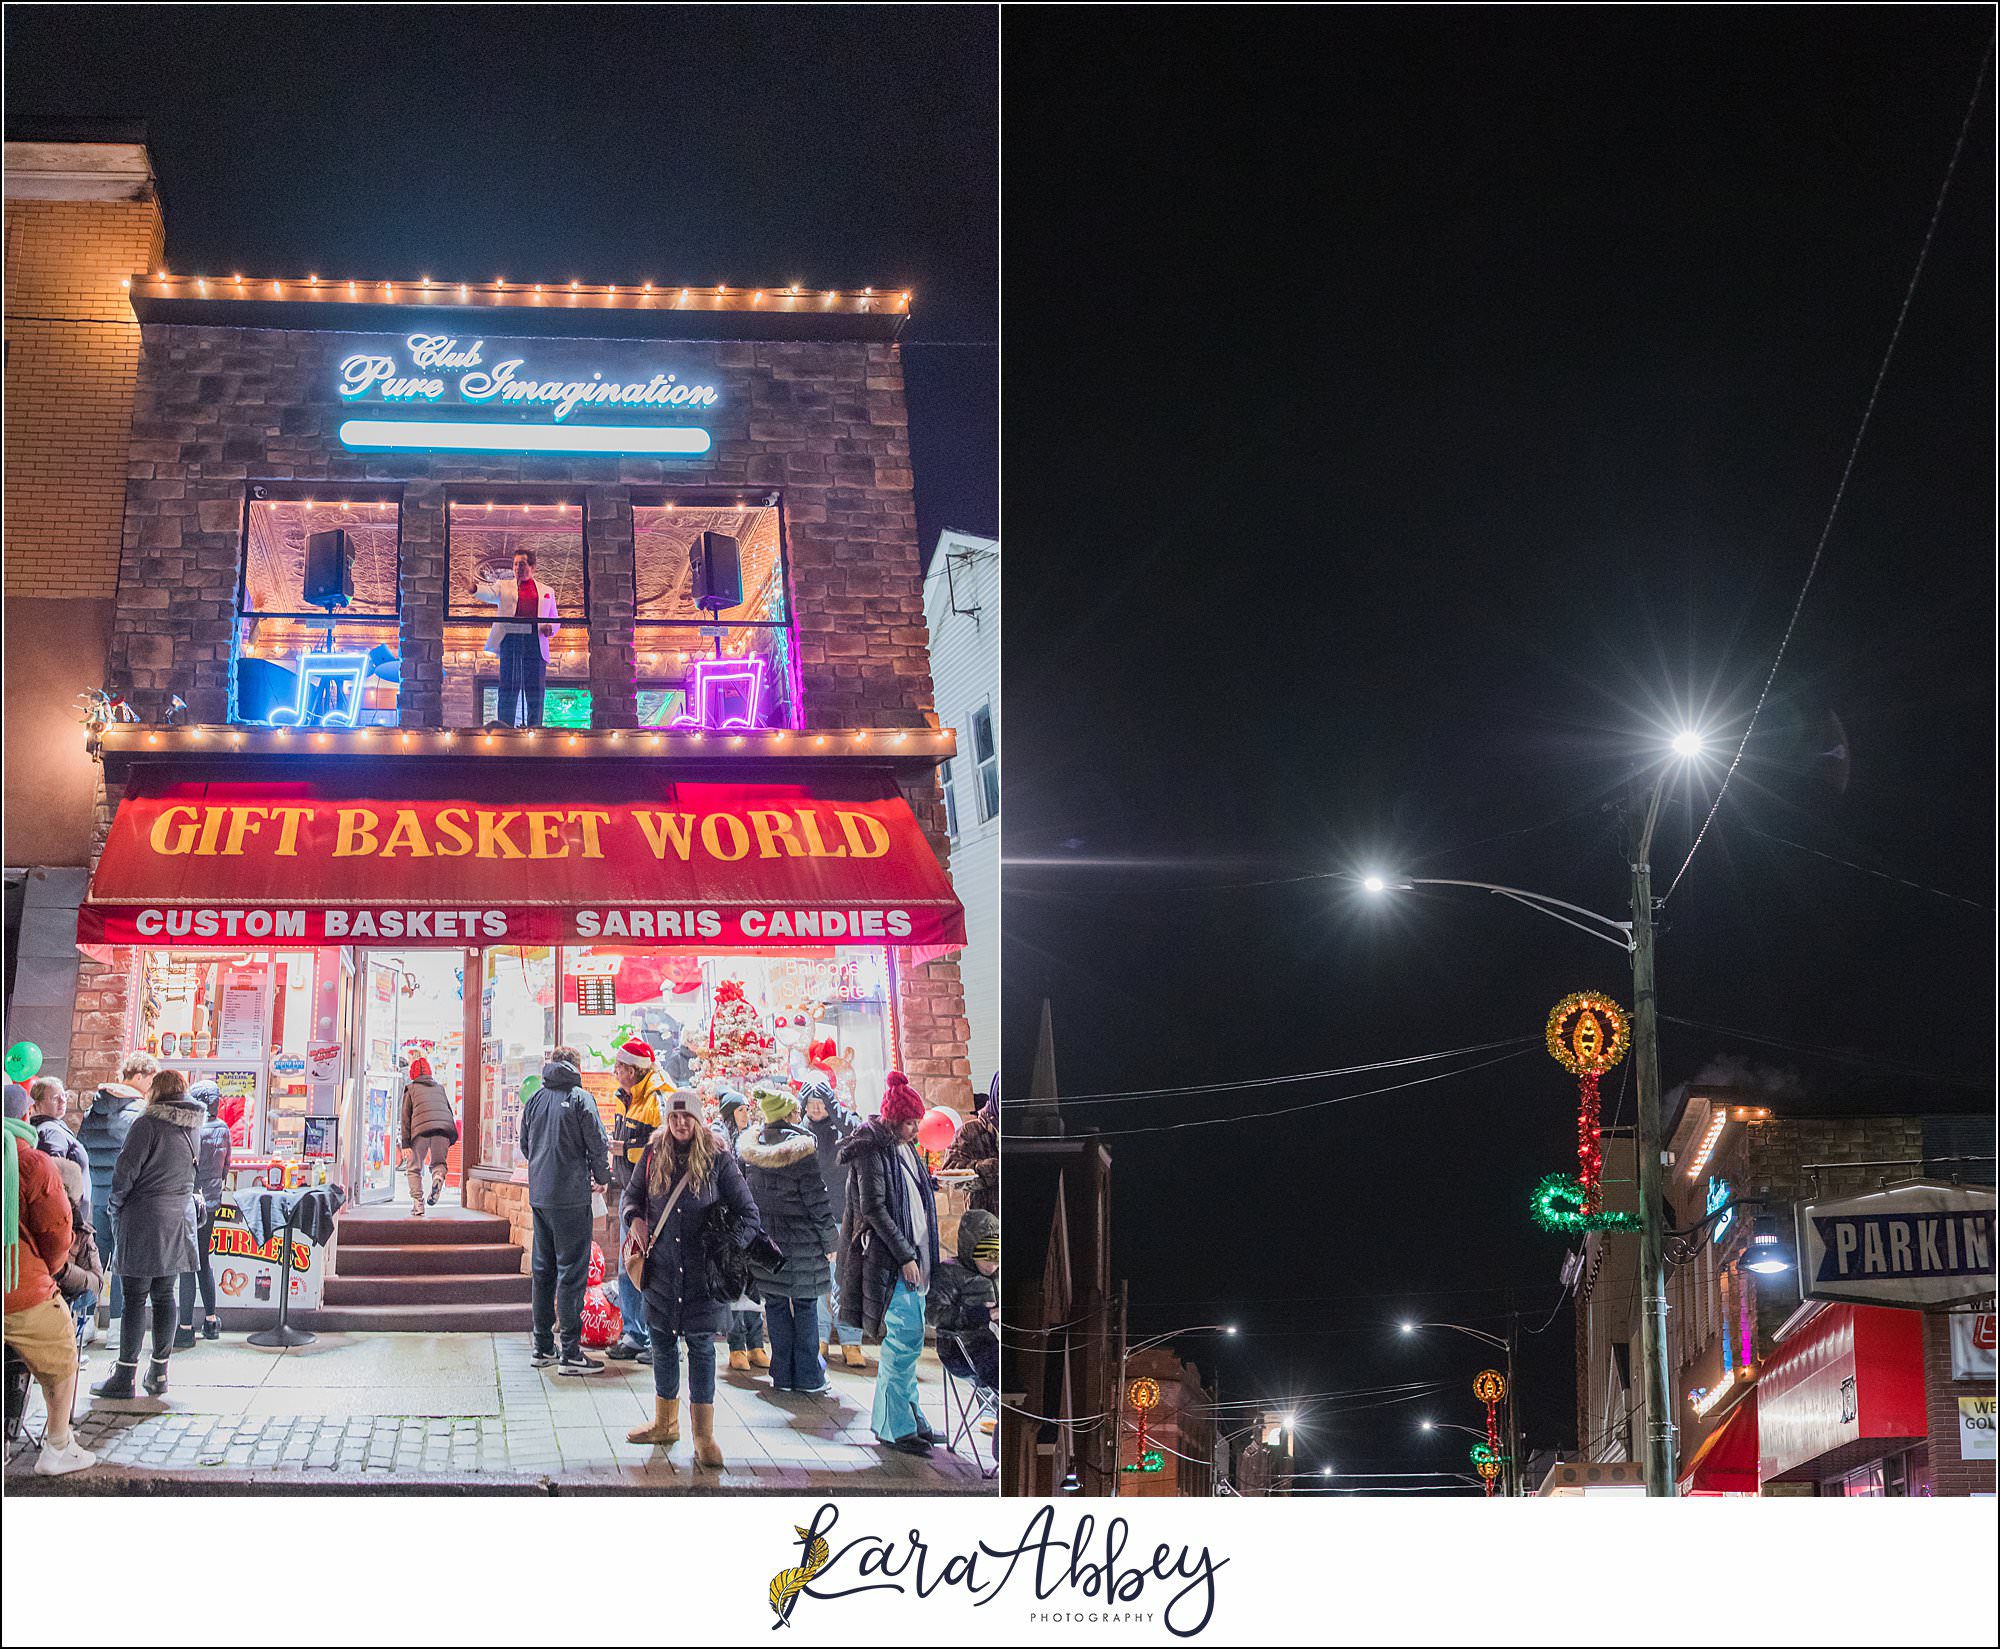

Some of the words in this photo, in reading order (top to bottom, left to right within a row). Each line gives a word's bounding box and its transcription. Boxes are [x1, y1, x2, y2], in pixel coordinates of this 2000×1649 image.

[406, 333, 483, 369] Club
[339, 354, 444, 398] Pure
[459, 359, 719, 419] Imagination
[150, 806, 313, 855] GIFT
[331, 808, 610, 859] BASKET
[631, 809, 891, 860] WORLD
[136, 909, 306, 937] CUSTOM
[324, 910, 508, 938] BASKETS
[576, 911, 722, 938] SARRIS
[739, 910, 912, 938] CANDIES
[1835, 1217, 1996, 1275] PARKIN
